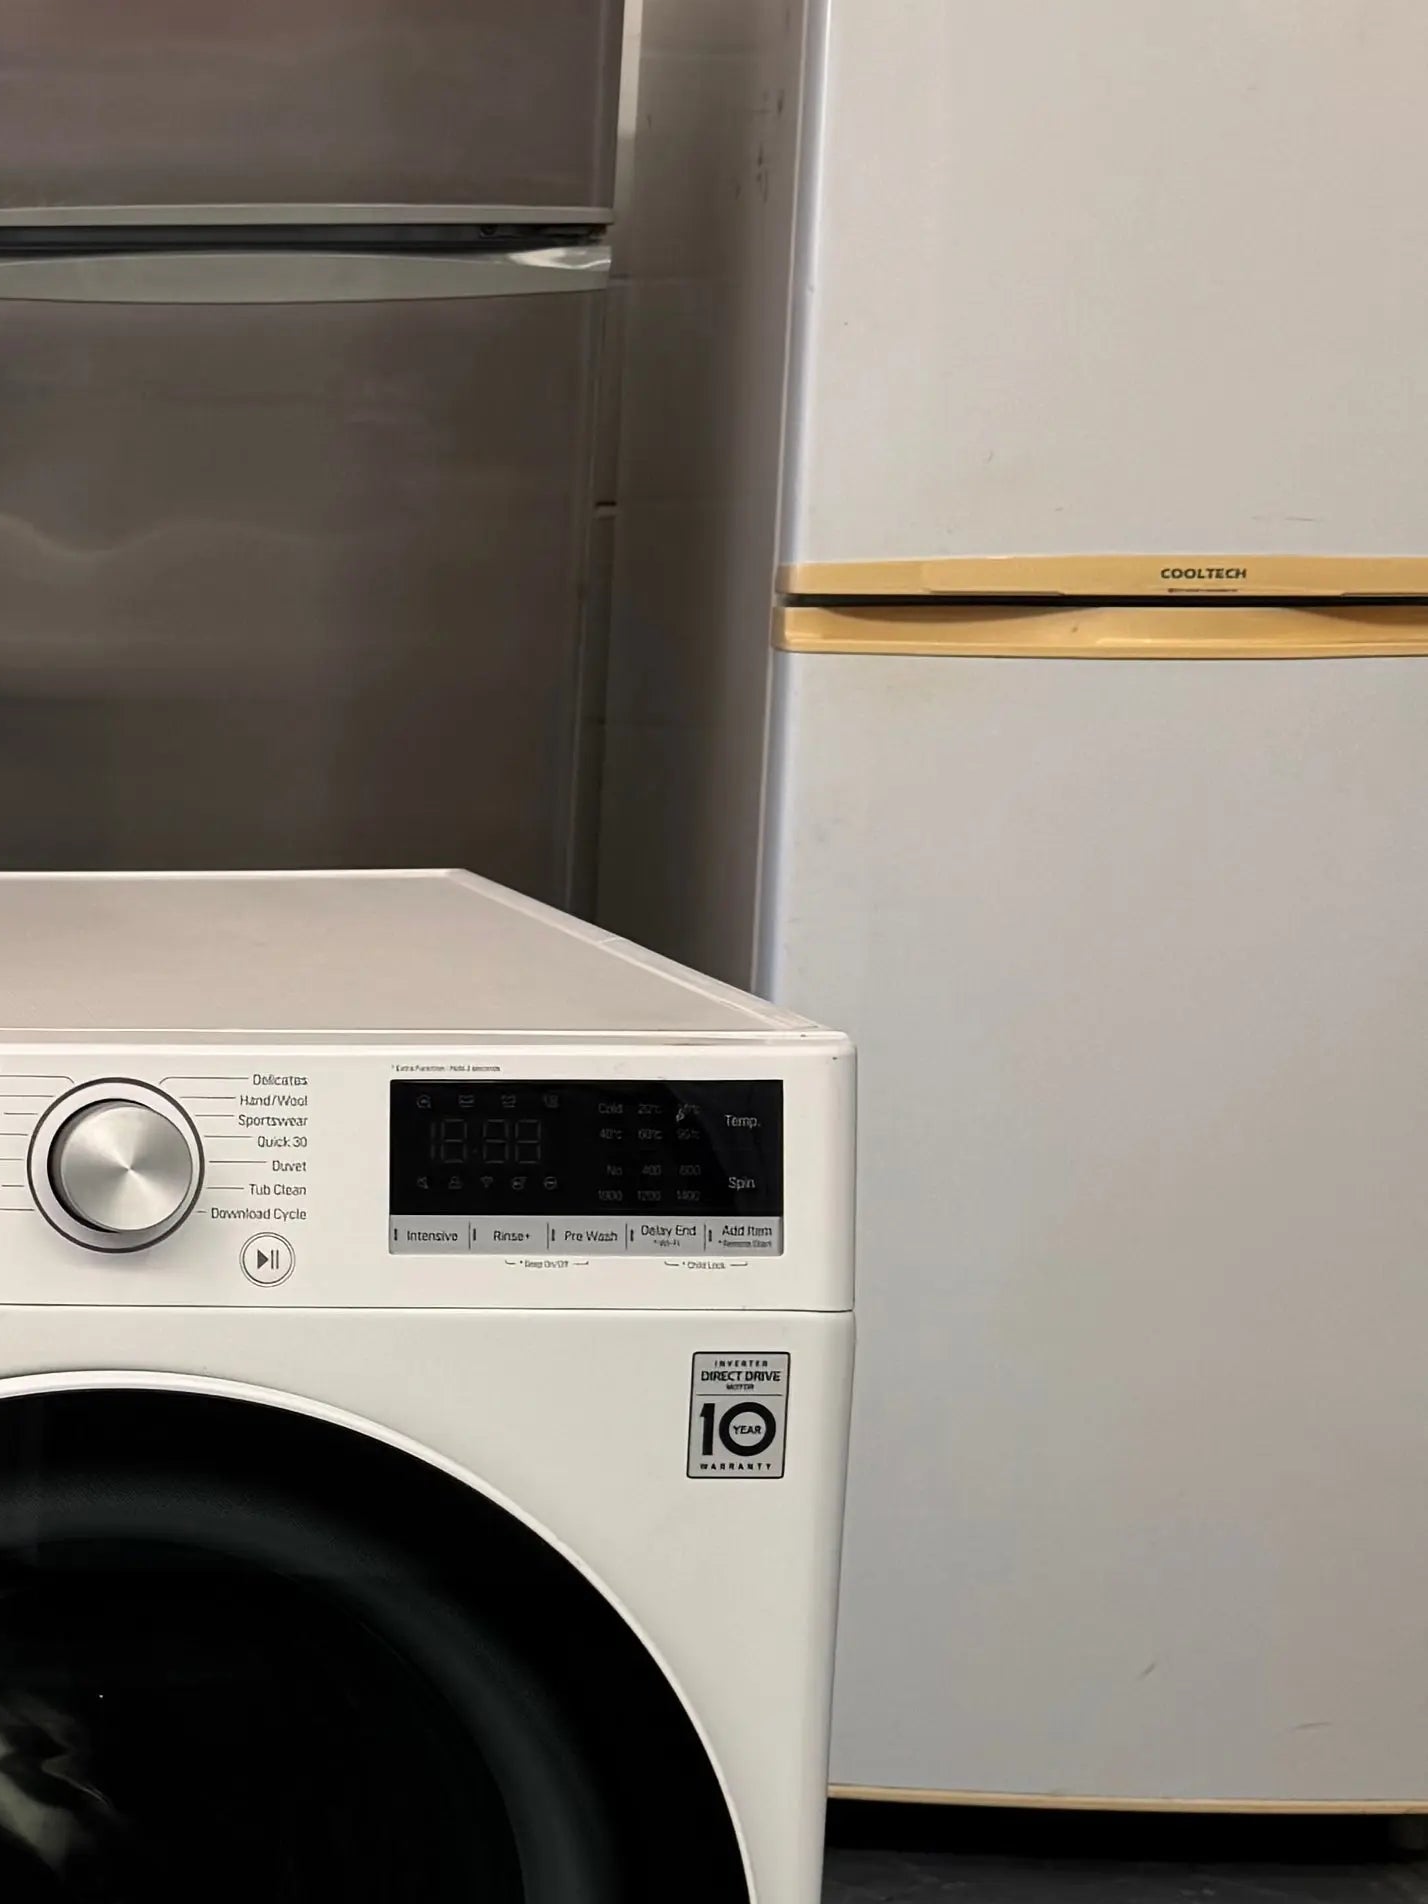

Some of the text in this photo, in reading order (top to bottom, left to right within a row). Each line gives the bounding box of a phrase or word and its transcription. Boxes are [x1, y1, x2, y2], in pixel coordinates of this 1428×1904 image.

[1160, 568, 1247, 579] COOLTECH
[253, 1073, 308, 1086] Delicates
[240, 1095, 308, 1108] Hand/Wool
[238, 1113, 308, 1128] Sportswear
[724, 1114, 761, 1129] Temp.
[257, 1135, 308, 1148] Quick 30
[272, 1160, 307, 1172] Duvet
[249, 1183, 307, 1196] Tub Clean
[728, 1176, 755, 1191] Spin
[211, 1207, 307, 1222] Download Cycle
[407, 1231, 458, 1241] Intensive
[564, 1231, 618, 1241] Pre Wash
[641, 1225, 696, 1237] Delay End
[722, 1225, 772, 1236] Add Item
[701, 1371, 781, 1381] DIRECT DRIVE
[699, 1402, 776, 1456] 10
[733, 1425, 762, 1434] YEAR
